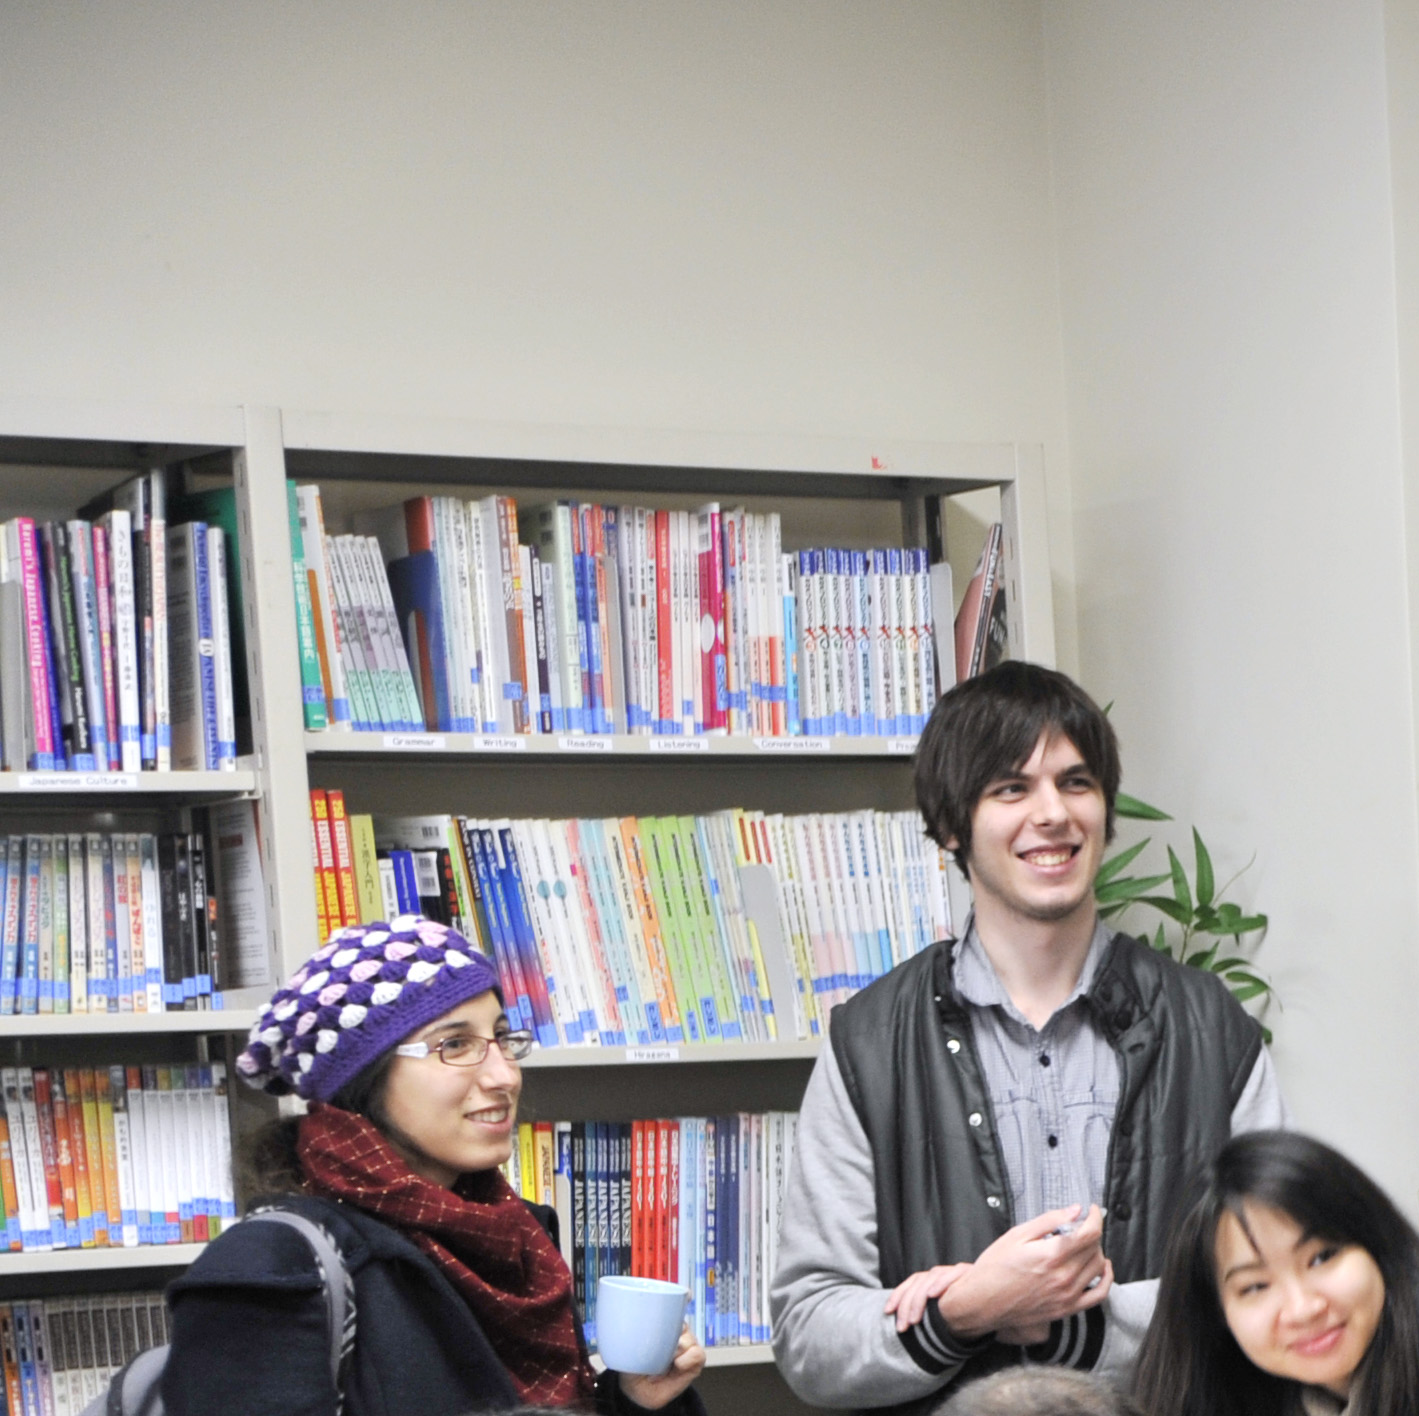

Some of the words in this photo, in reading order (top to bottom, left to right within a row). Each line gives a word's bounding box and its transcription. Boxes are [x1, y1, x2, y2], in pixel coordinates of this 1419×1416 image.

[31, 625, 42, 666] Cooking
[393, 738, 434, 747] Grammar
[483, 738, 517, 749] Writing
[567, 738, 605, 750] Reading
[657, 738, 701, 750] Listening
[761, 740, 823, 750] Conversation
[29, 776, 81, 787] Japanese
[86, 775, 127, 786] Culture
[317, 821, 333, 868] ESSENTIAL
[335, 821, 351, 868] ESSENTIAL
[323, 871, 341, 916] JAPANESE
[341, 871, 359, 916] JAPANESE
[626, 903, 634, 919] BOOK
[645, 903, 654, 920] BOOK
[684, 900, 692, 916] BOOK
[634, 1050, 670, 1060] Hiragana
[540, 1145, 550, 1186] JAPANESE
[574, 1179, 583, 1247] JAPANESE
[587, 1179, 596, 1246] JAPANESE
[598, 1179, 608, 1247] JAPANESE
[610, 1179, 619, 1247] JAPANESE
[621, 1178, 630, 1246] JAPANESE
